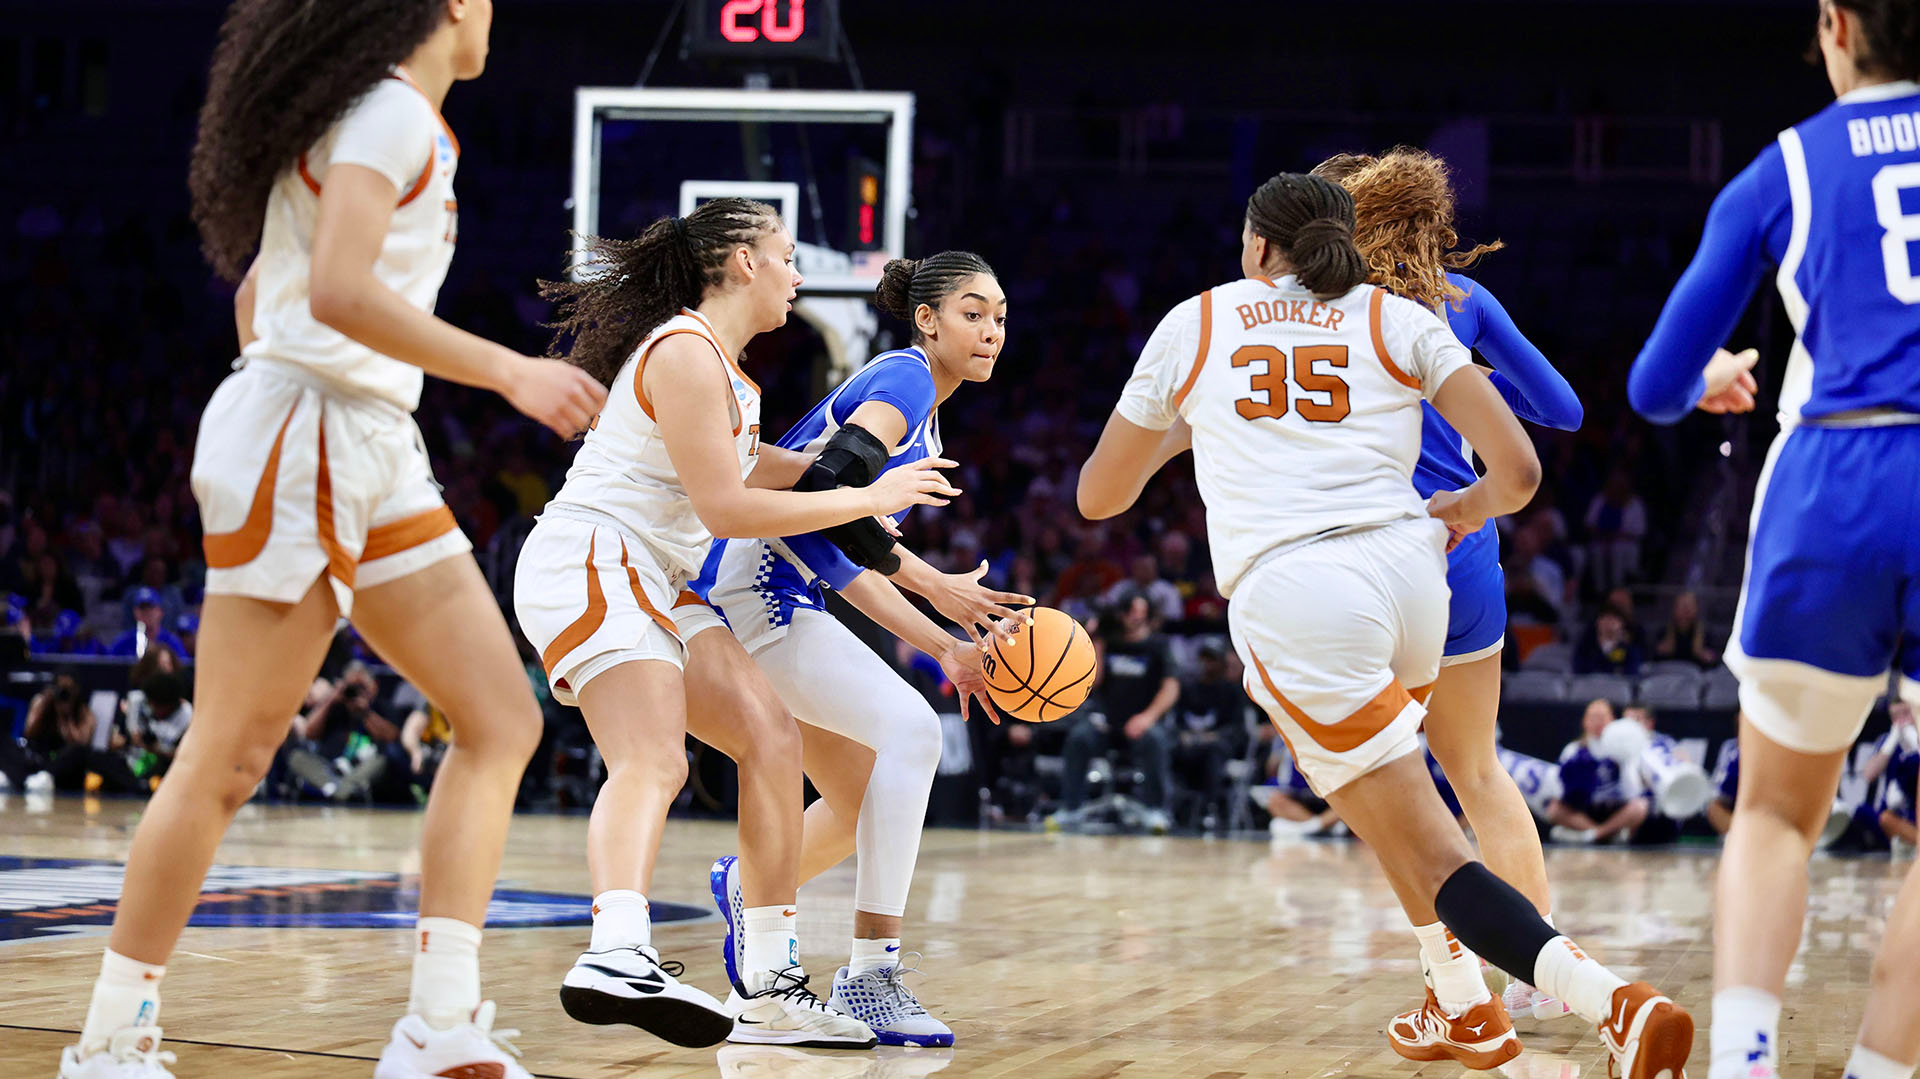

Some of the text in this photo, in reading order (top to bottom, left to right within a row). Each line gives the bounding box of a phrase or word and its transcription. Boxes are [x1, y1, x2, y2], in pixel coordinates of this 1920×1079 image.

[720, 0, 805, 42] 20
[1847, 111, 1920, 157] BOO
[1235, 299, 1345, 331] BOOKER
[1230, 344, 1351, 423] 35
